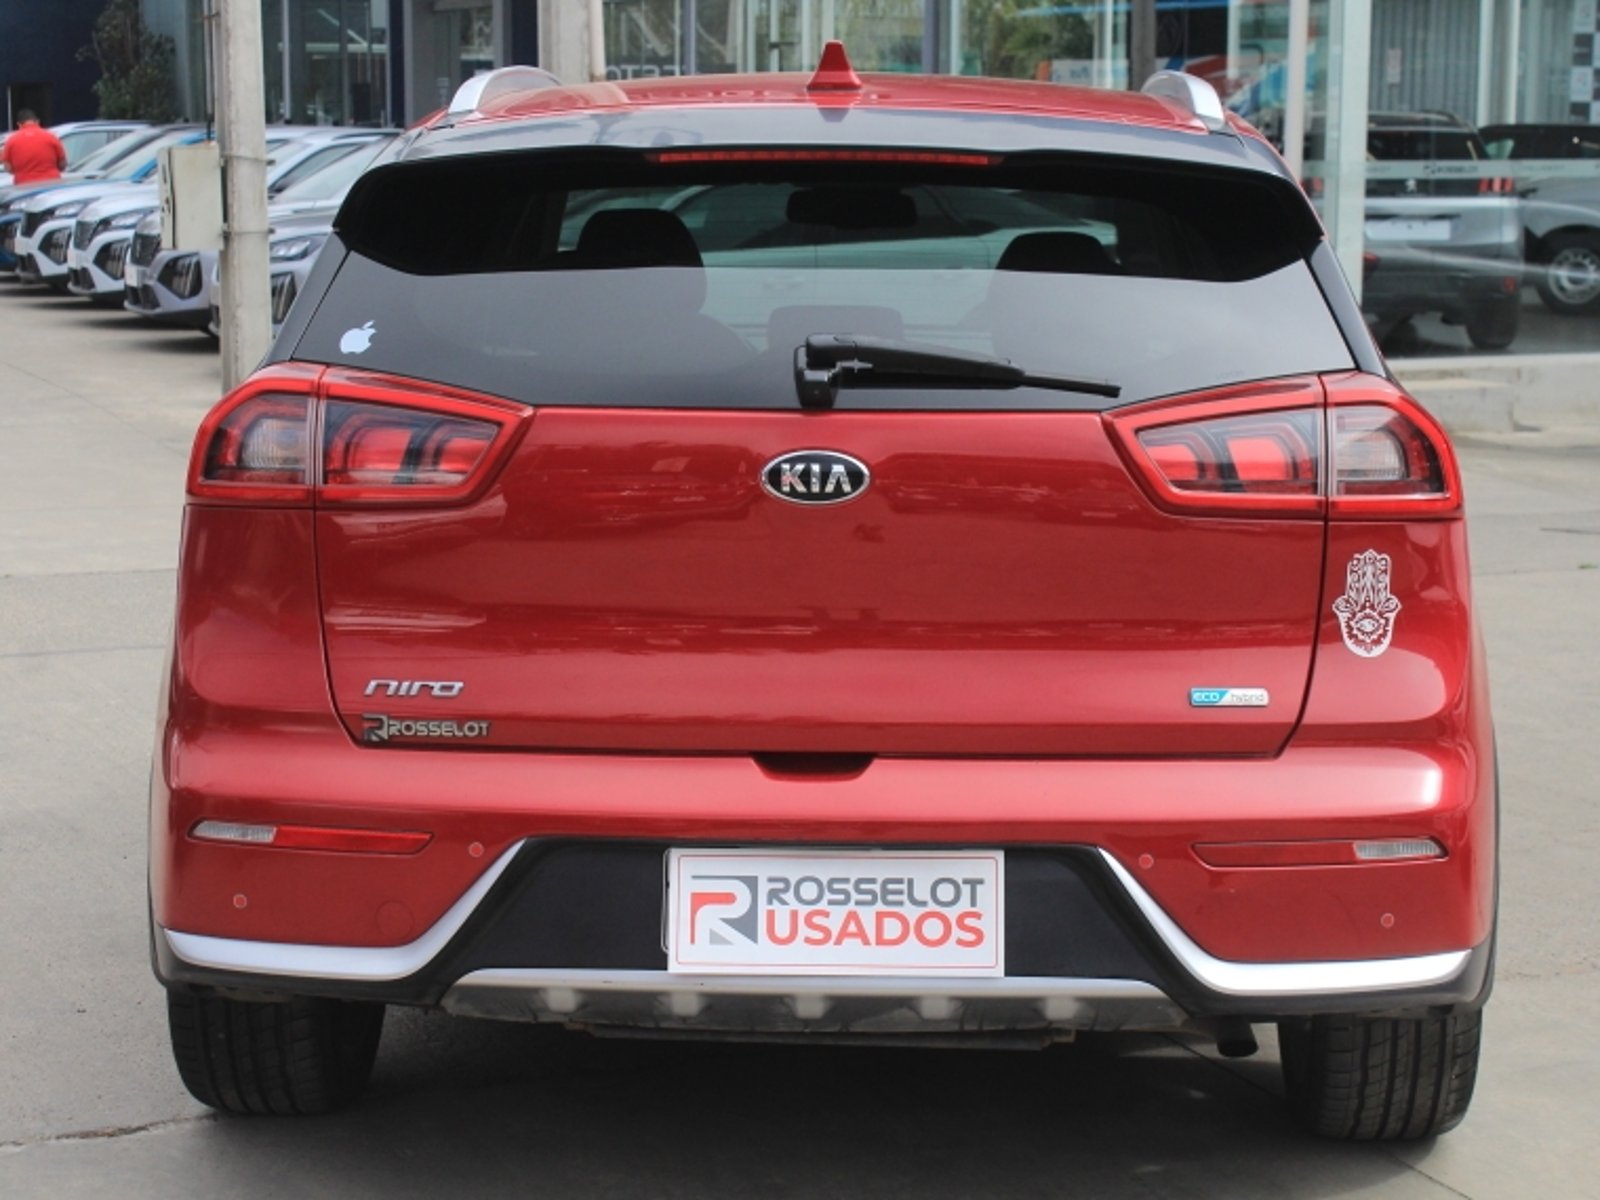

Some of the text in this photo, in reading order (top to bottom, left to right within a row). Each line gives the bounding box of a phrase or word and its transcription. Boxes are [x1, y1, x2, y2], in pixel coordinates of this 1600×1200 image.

[780, 463, 852, 493] KIA
[389, 720, 490, 737] ROSSELOT
[766, 876, 986, 908] ROSSELOT
[766, 909, 986, 949] USADOS
